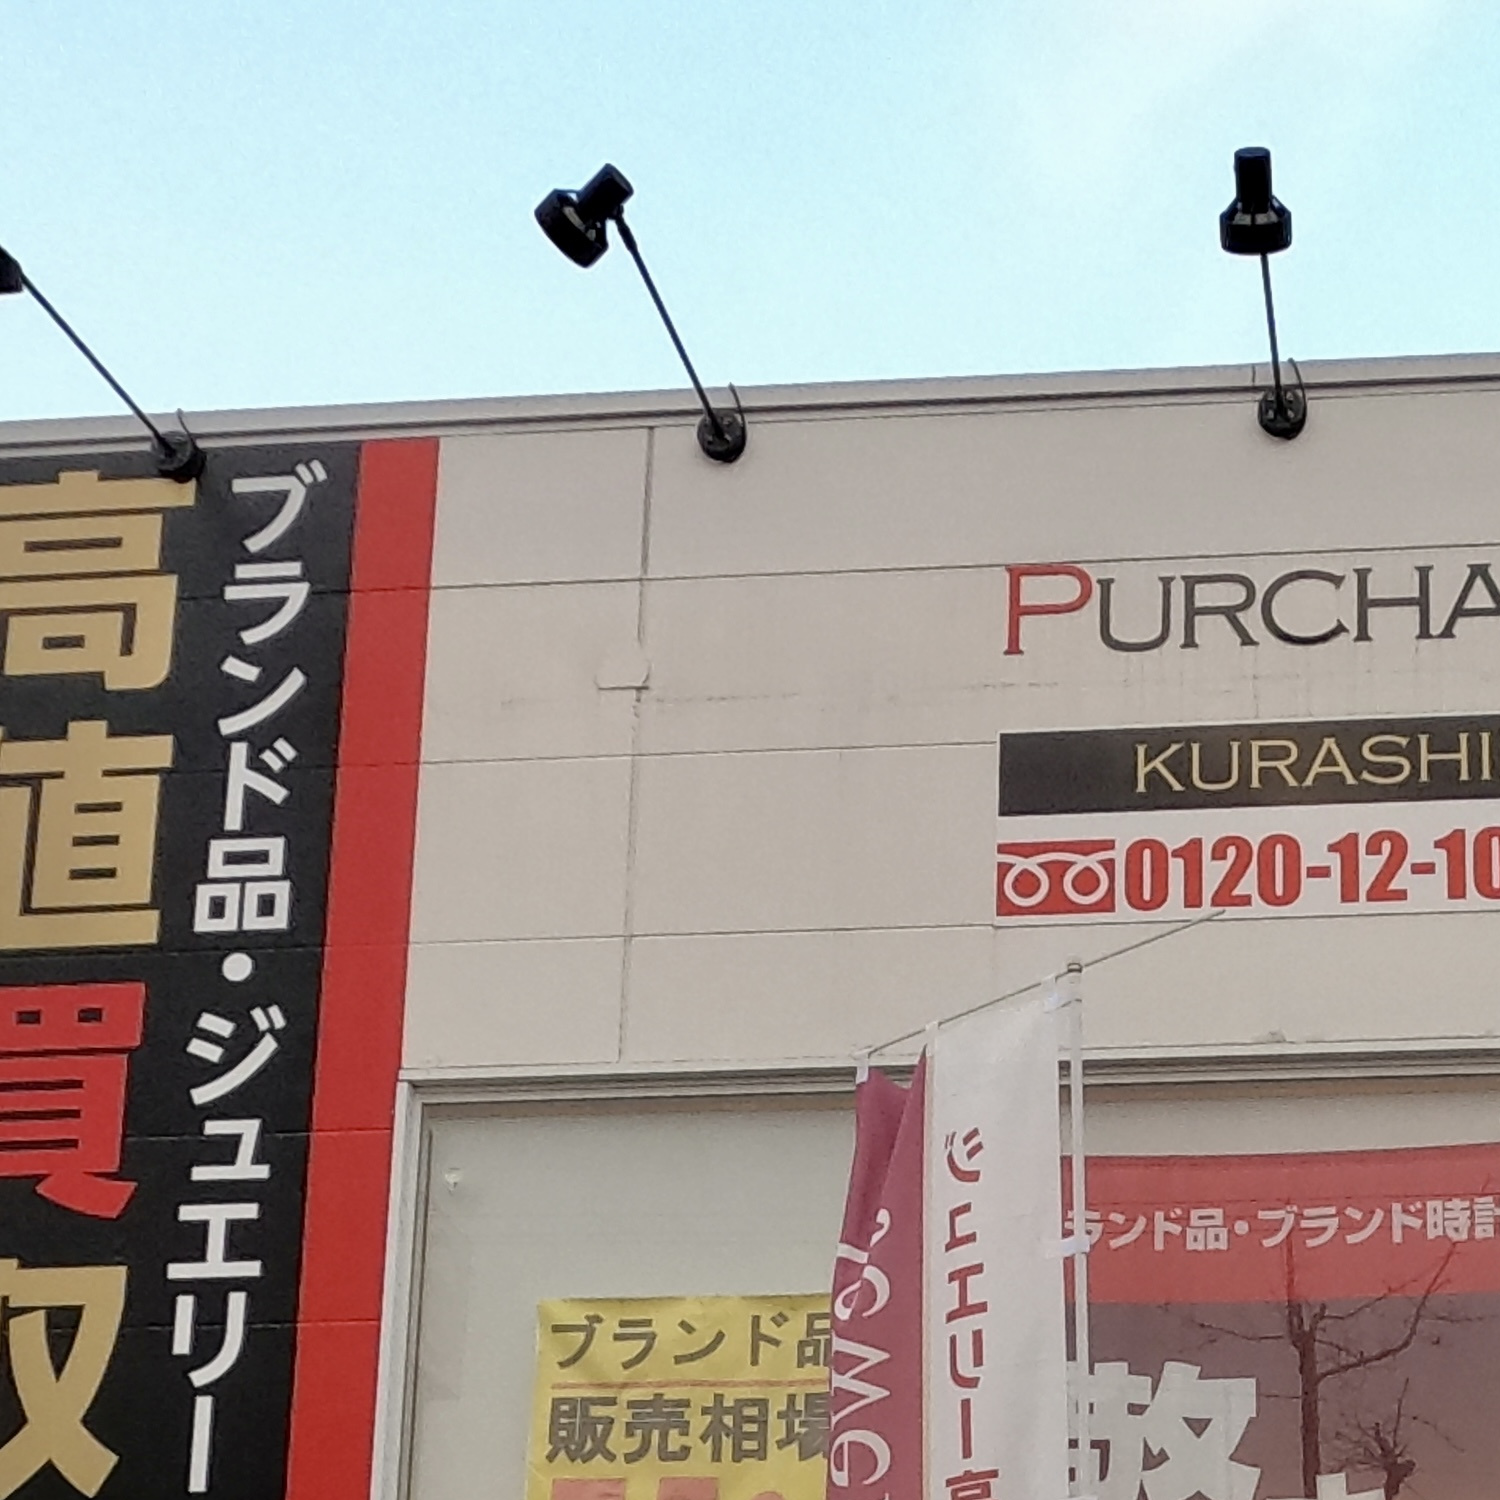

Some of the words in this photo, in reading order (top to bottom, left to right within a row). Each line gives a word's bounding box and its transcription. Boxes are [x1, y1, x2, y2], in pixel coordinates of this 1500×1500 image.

[167, 459, 327, 1493] ブランド品・ジュエリー
